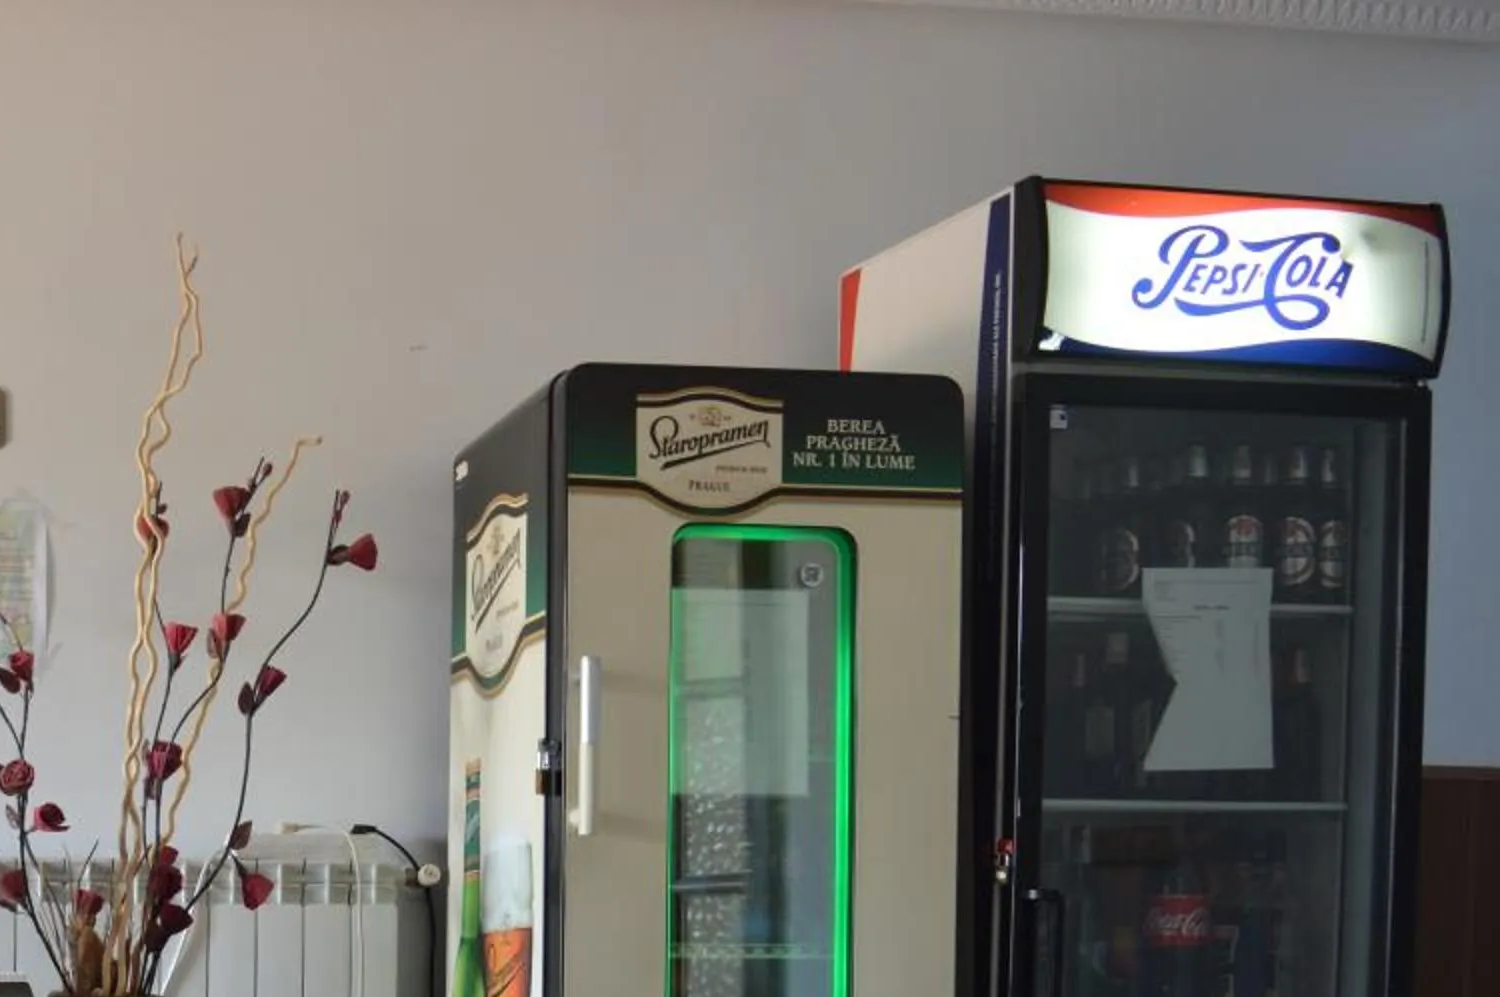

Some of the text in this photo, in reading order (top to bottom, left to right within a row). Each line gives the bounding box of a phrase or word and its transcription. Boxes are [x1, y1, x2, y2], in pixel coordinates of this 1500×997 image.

[827, 418, 885, 435] BEREA
[648, 415, 771, 460] Staropramen
[793, 449, 915, 470] NR. 1 ÎN LUME
